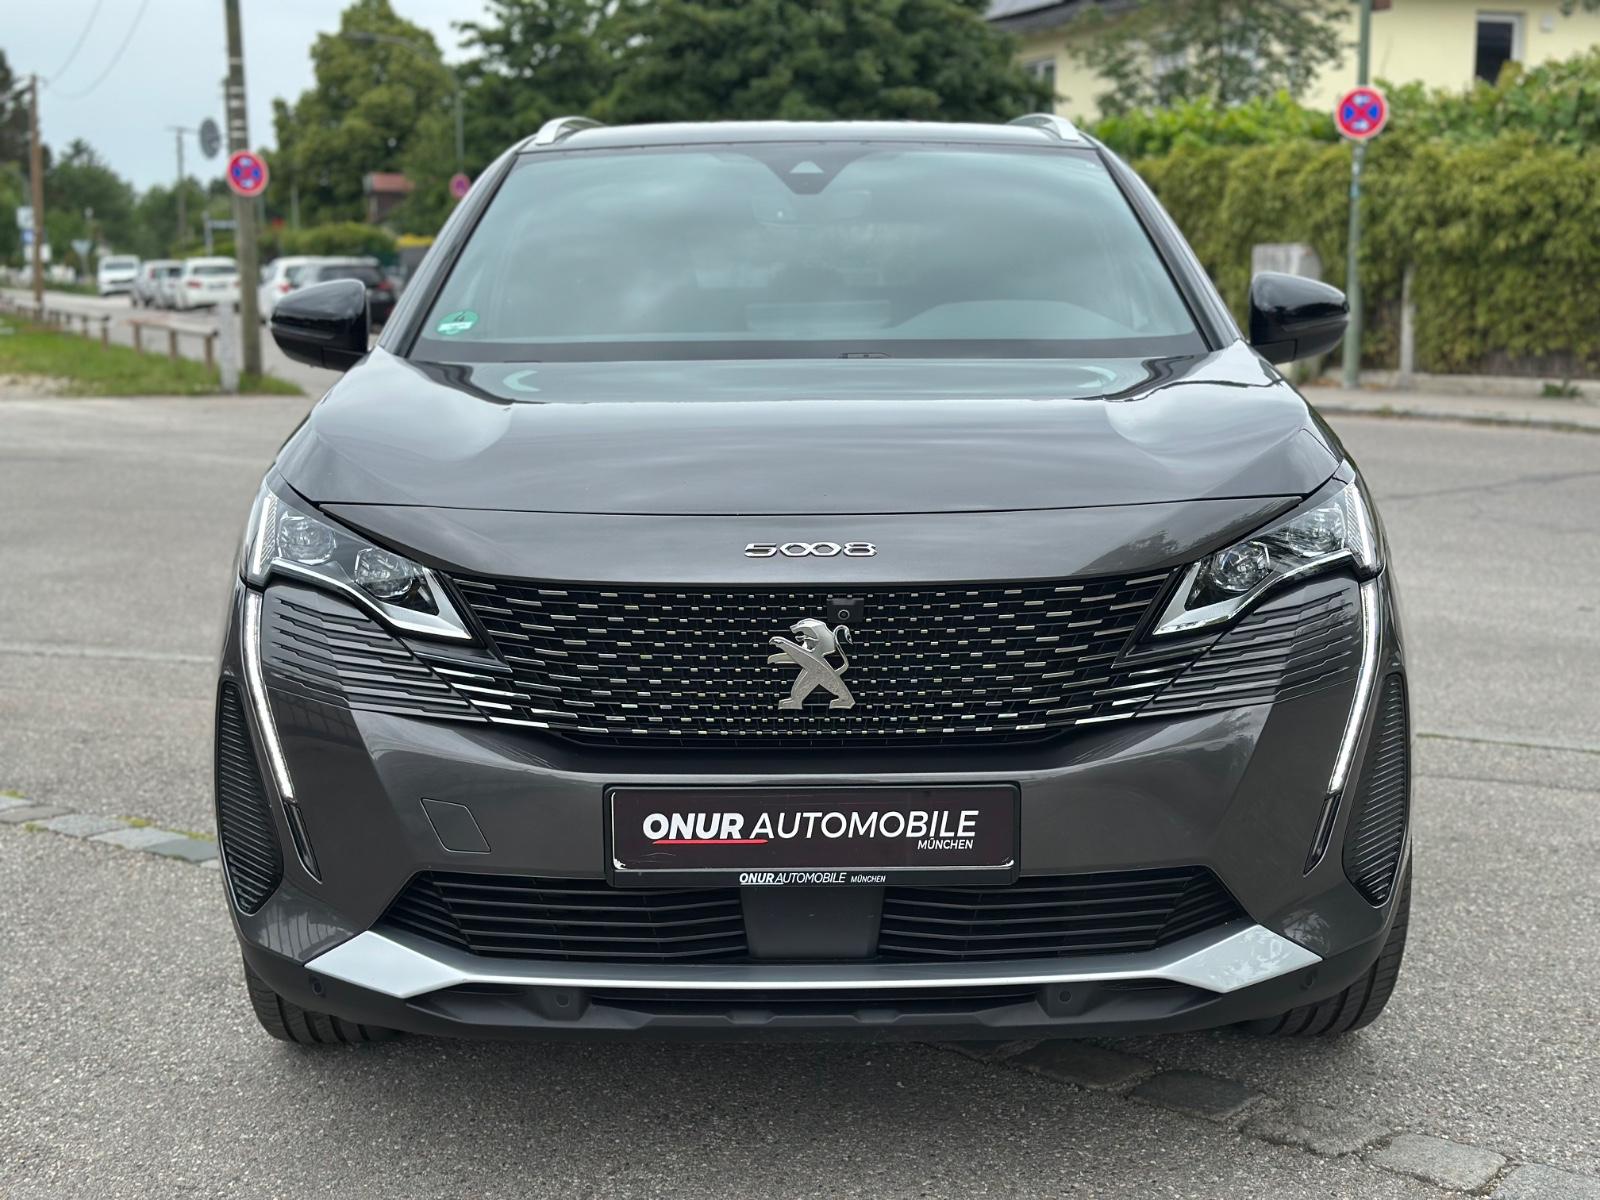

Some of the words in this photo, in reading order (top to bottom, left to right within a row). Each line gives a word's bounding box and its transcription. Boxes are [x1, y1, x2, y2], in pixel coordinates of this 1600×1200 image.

[744, 541, 878, 558] 5008
[642, 812, 745, 840] ONUR
[749, 810, 980, 839] AUTOMOBILE
[917, 837, 974, 850] MÜNCHEN
[850, 874, 887, 883] MÜNCHEN
